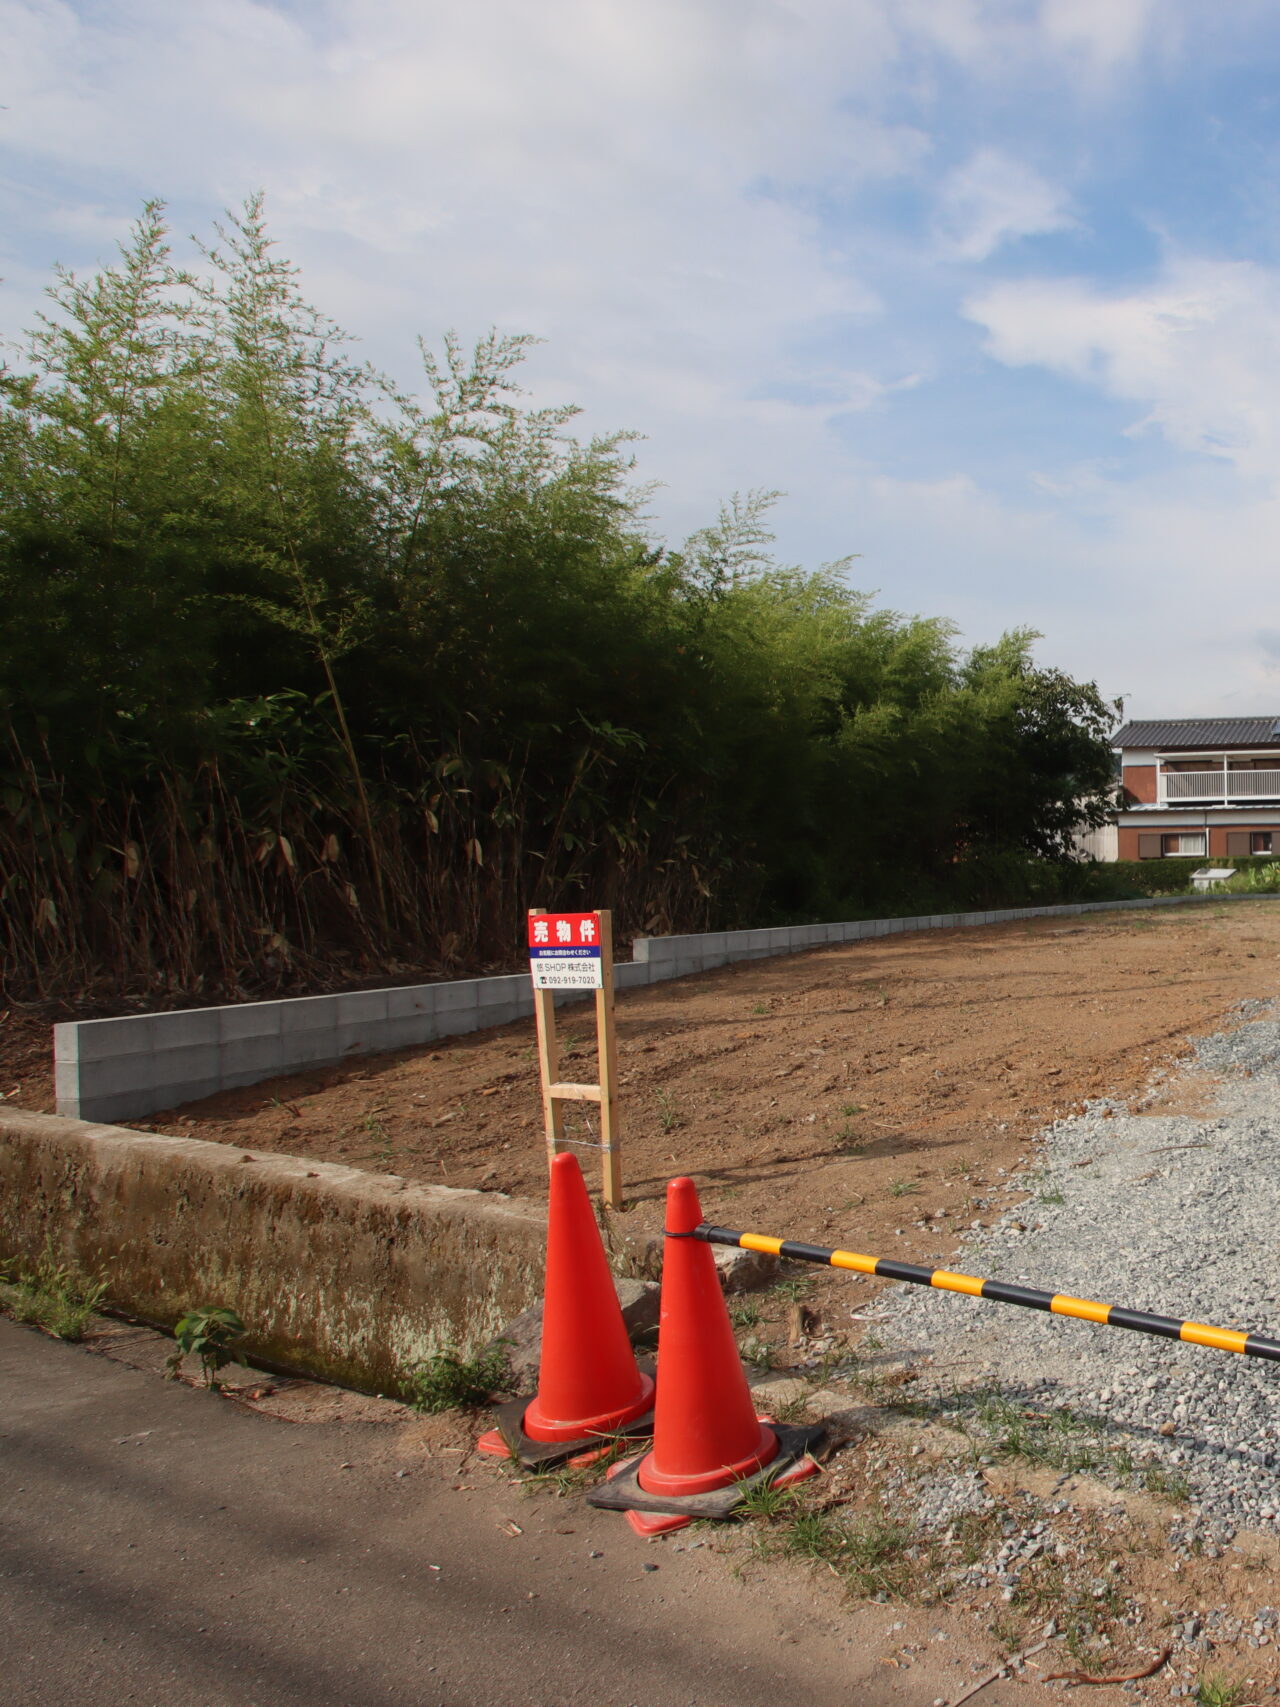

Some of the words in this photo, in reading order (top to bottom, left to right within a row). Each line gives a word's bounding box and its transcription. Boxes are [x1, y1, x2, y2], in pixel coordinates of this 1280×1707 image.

[534, 921, 594, 942] 売物件
[549, 976, 595, 984] 092-919-7020
